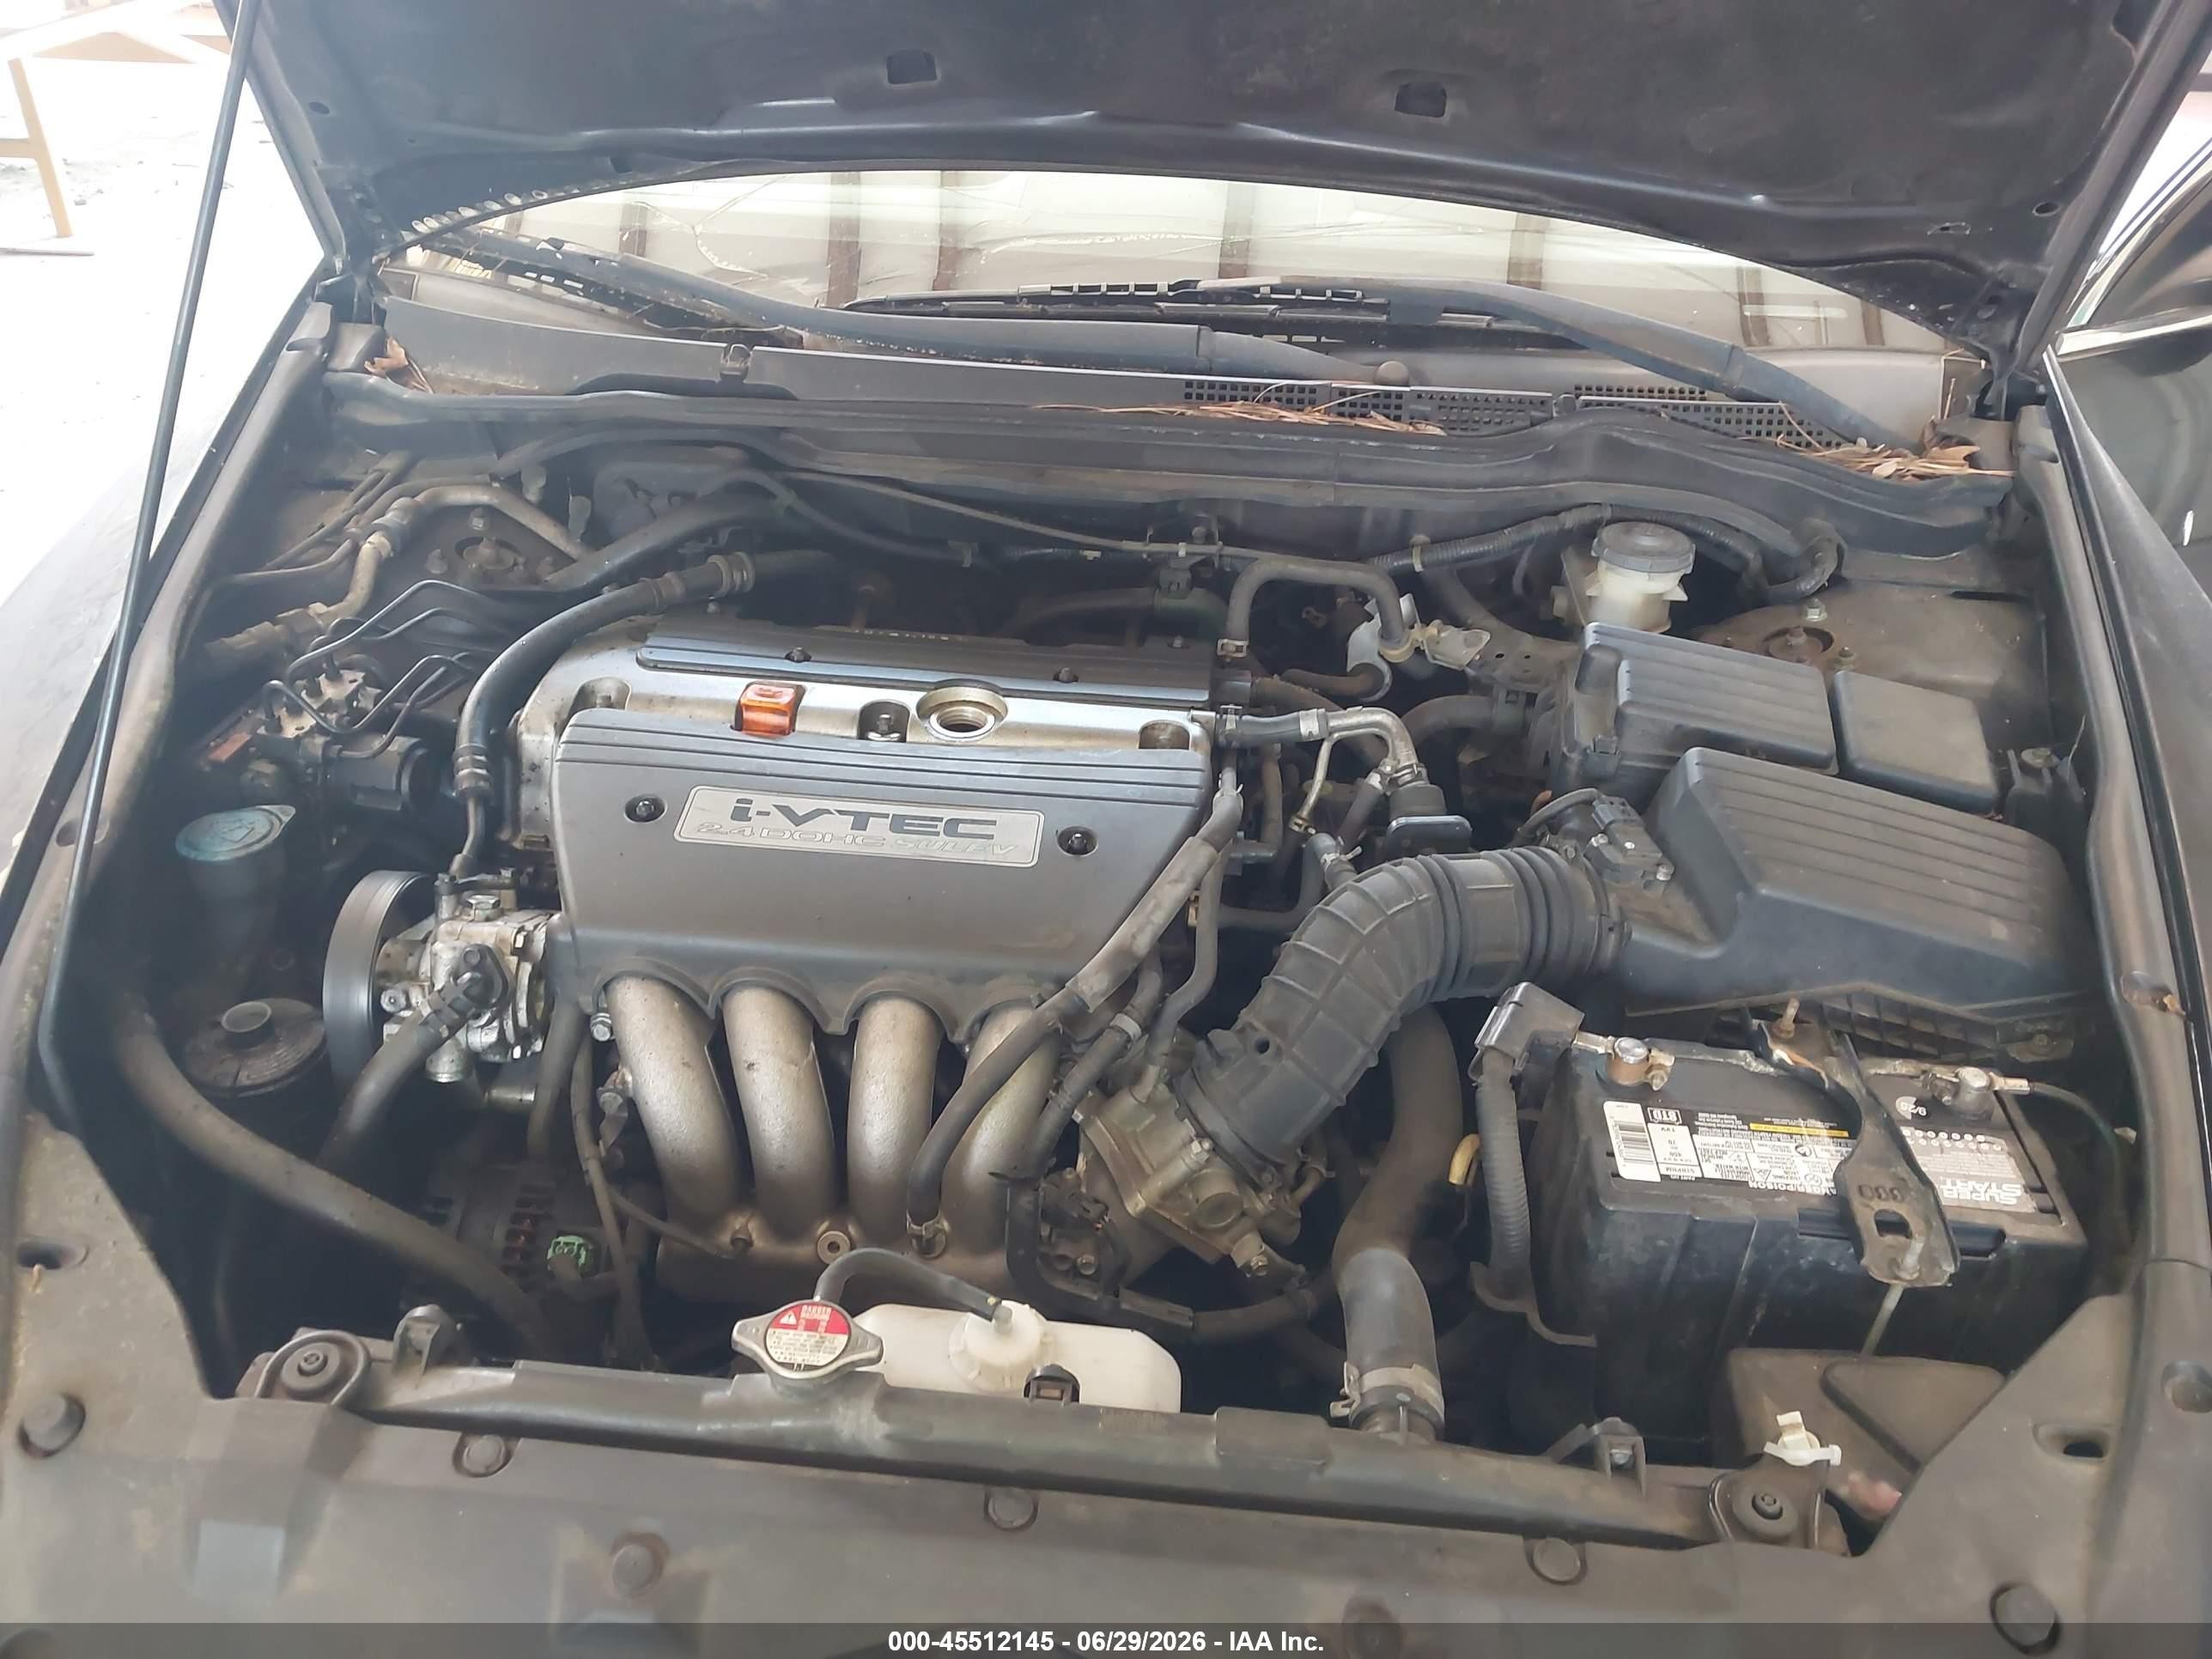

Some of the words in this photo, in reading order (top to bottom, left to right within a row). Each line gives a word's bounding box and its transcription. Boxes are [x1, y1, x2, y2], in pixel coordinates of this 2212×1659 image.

[730, 797, 998, 840] i-VTEC
[1940, 1179, 2021, 1197] START
[1942, 1188, 2018, 1206] SUPER
